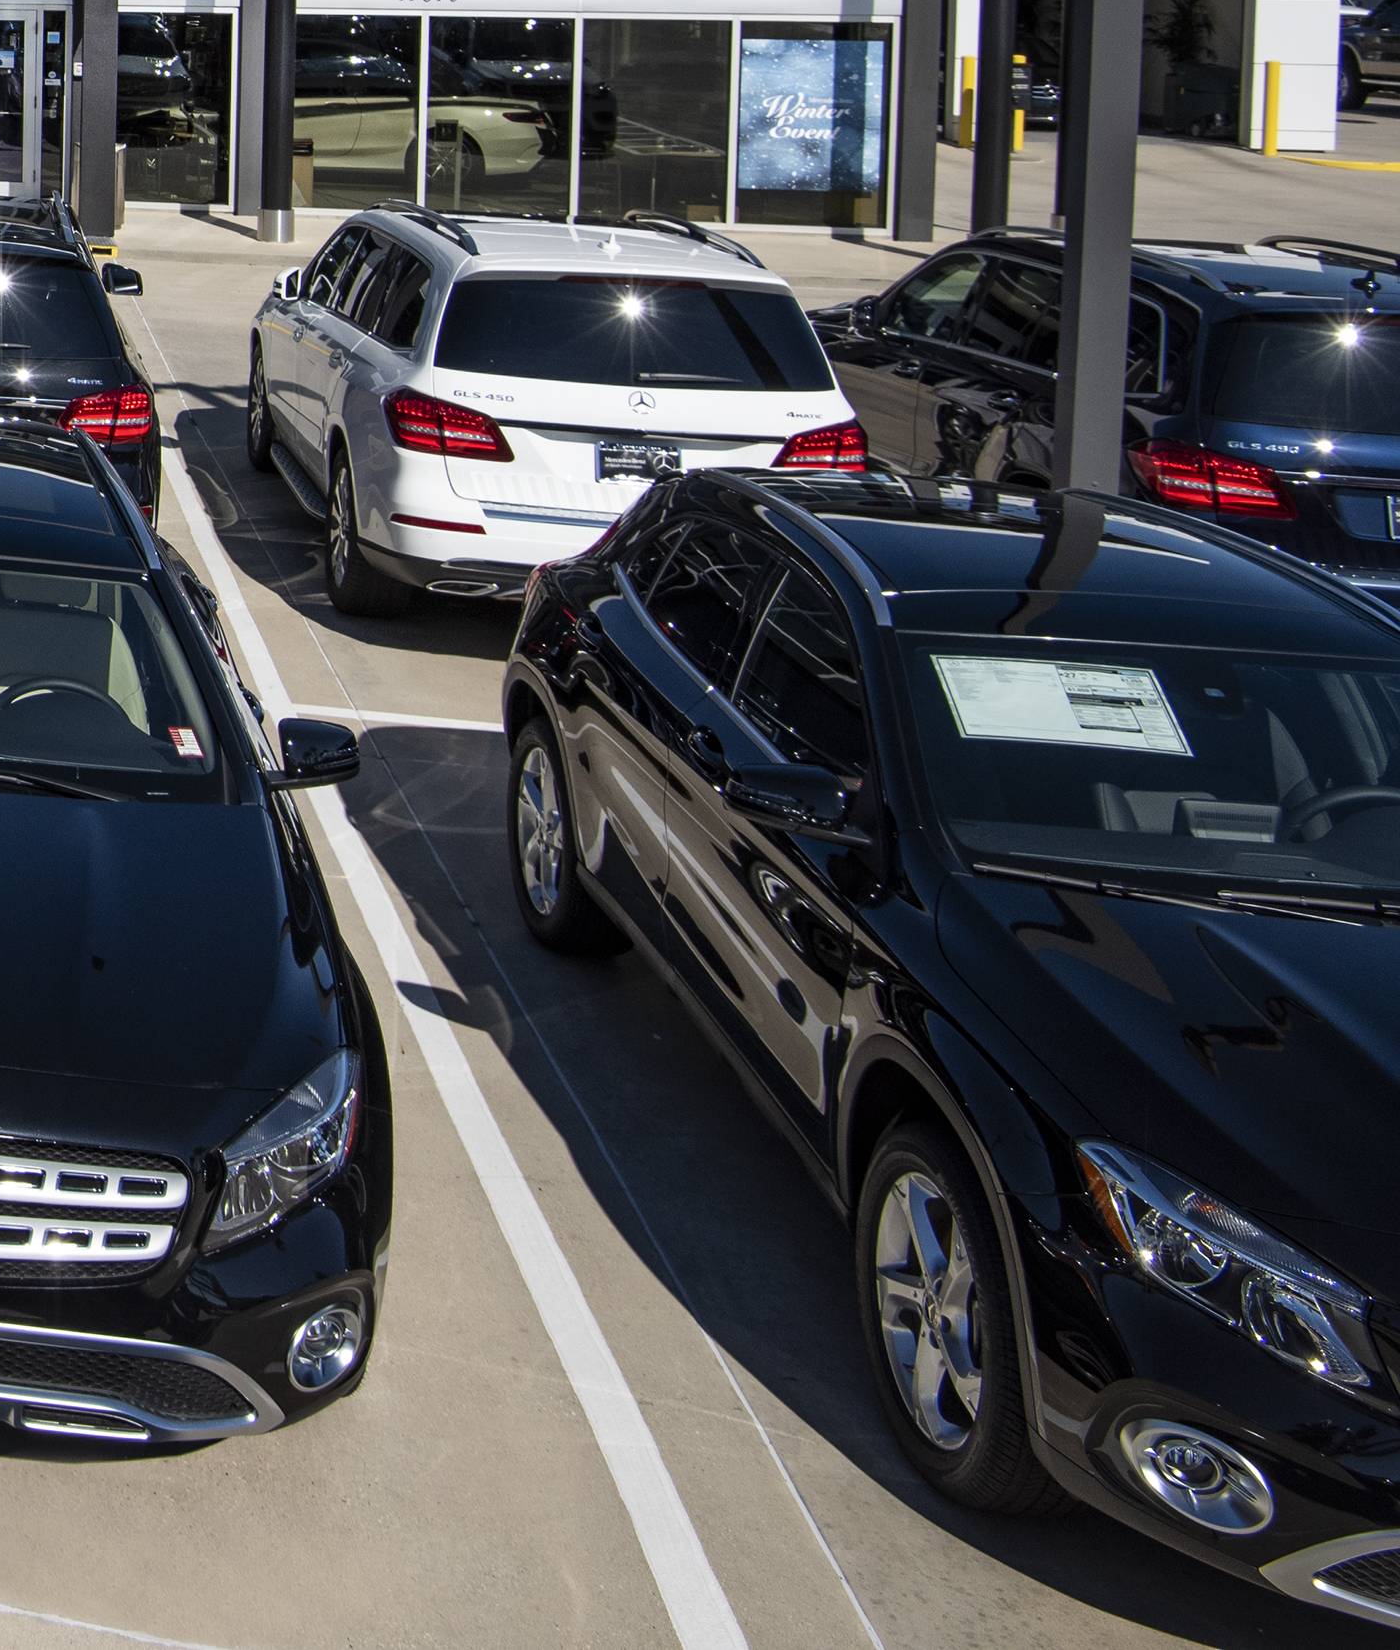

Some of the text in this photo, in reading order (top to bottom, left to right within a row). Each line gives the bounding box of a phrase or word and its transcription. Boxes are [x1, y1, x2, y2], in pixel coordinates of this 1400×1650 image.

[762, 91, 851, 119] Winter
[769, 115, 842, 140] Event
[453, 389, 515, 403] GLS 450
[1227, 440, 1262, 450] GLS
